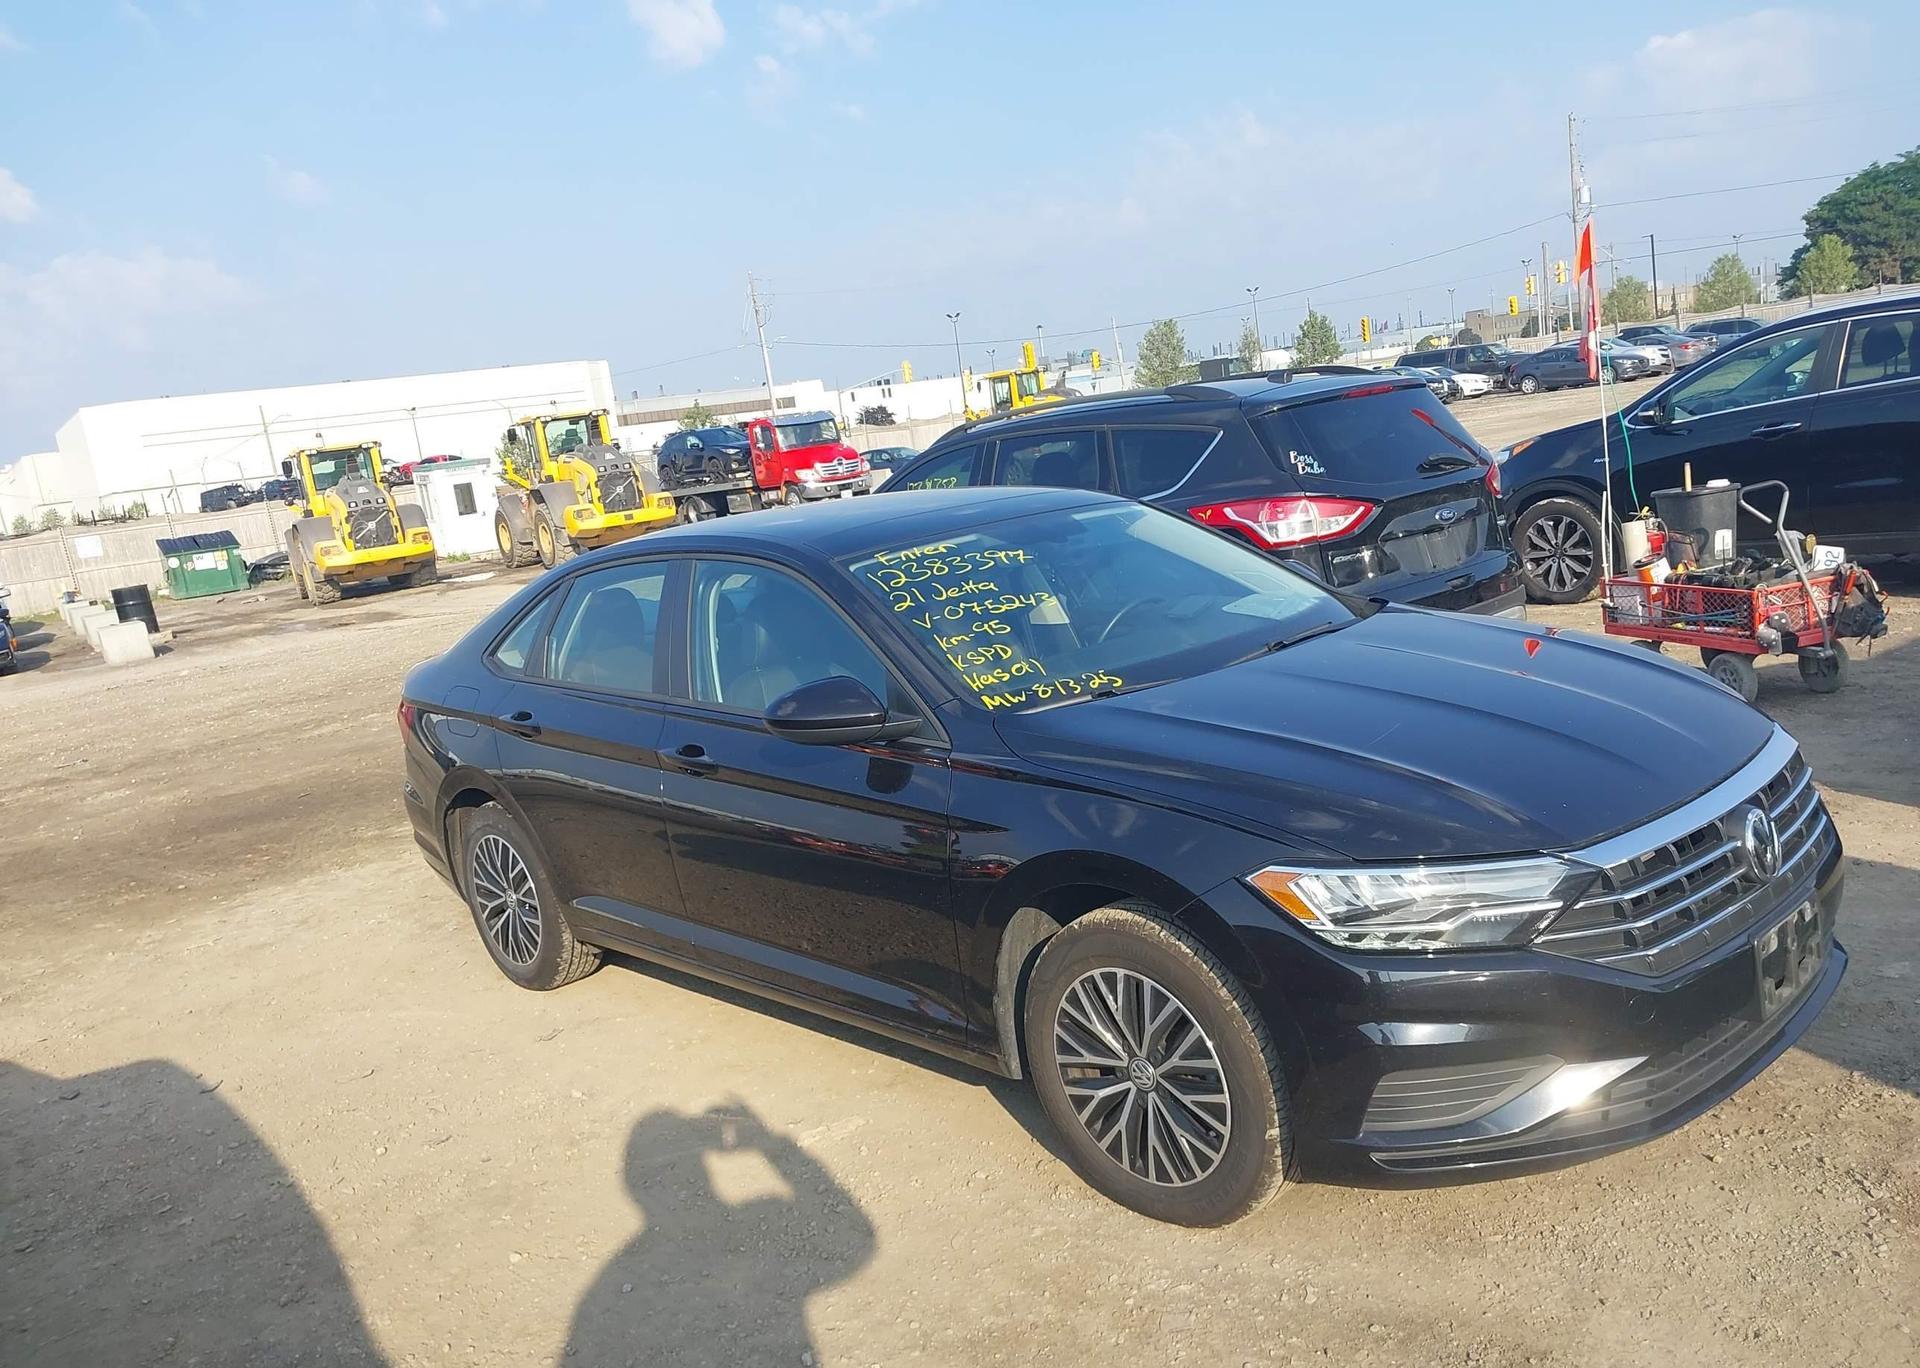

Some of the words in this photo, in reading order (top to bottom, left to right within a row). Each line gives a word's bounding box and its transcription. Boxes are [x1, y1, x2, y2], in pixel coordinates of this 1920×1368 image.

[1289, 450, 1314, 464] Boss
[1297, 461, 1328, 475] Babe
[866, 549, 1034, 592] 12383397
[889, 587, 926, 612] 21
[931, 579, 999, 601] Jetta
